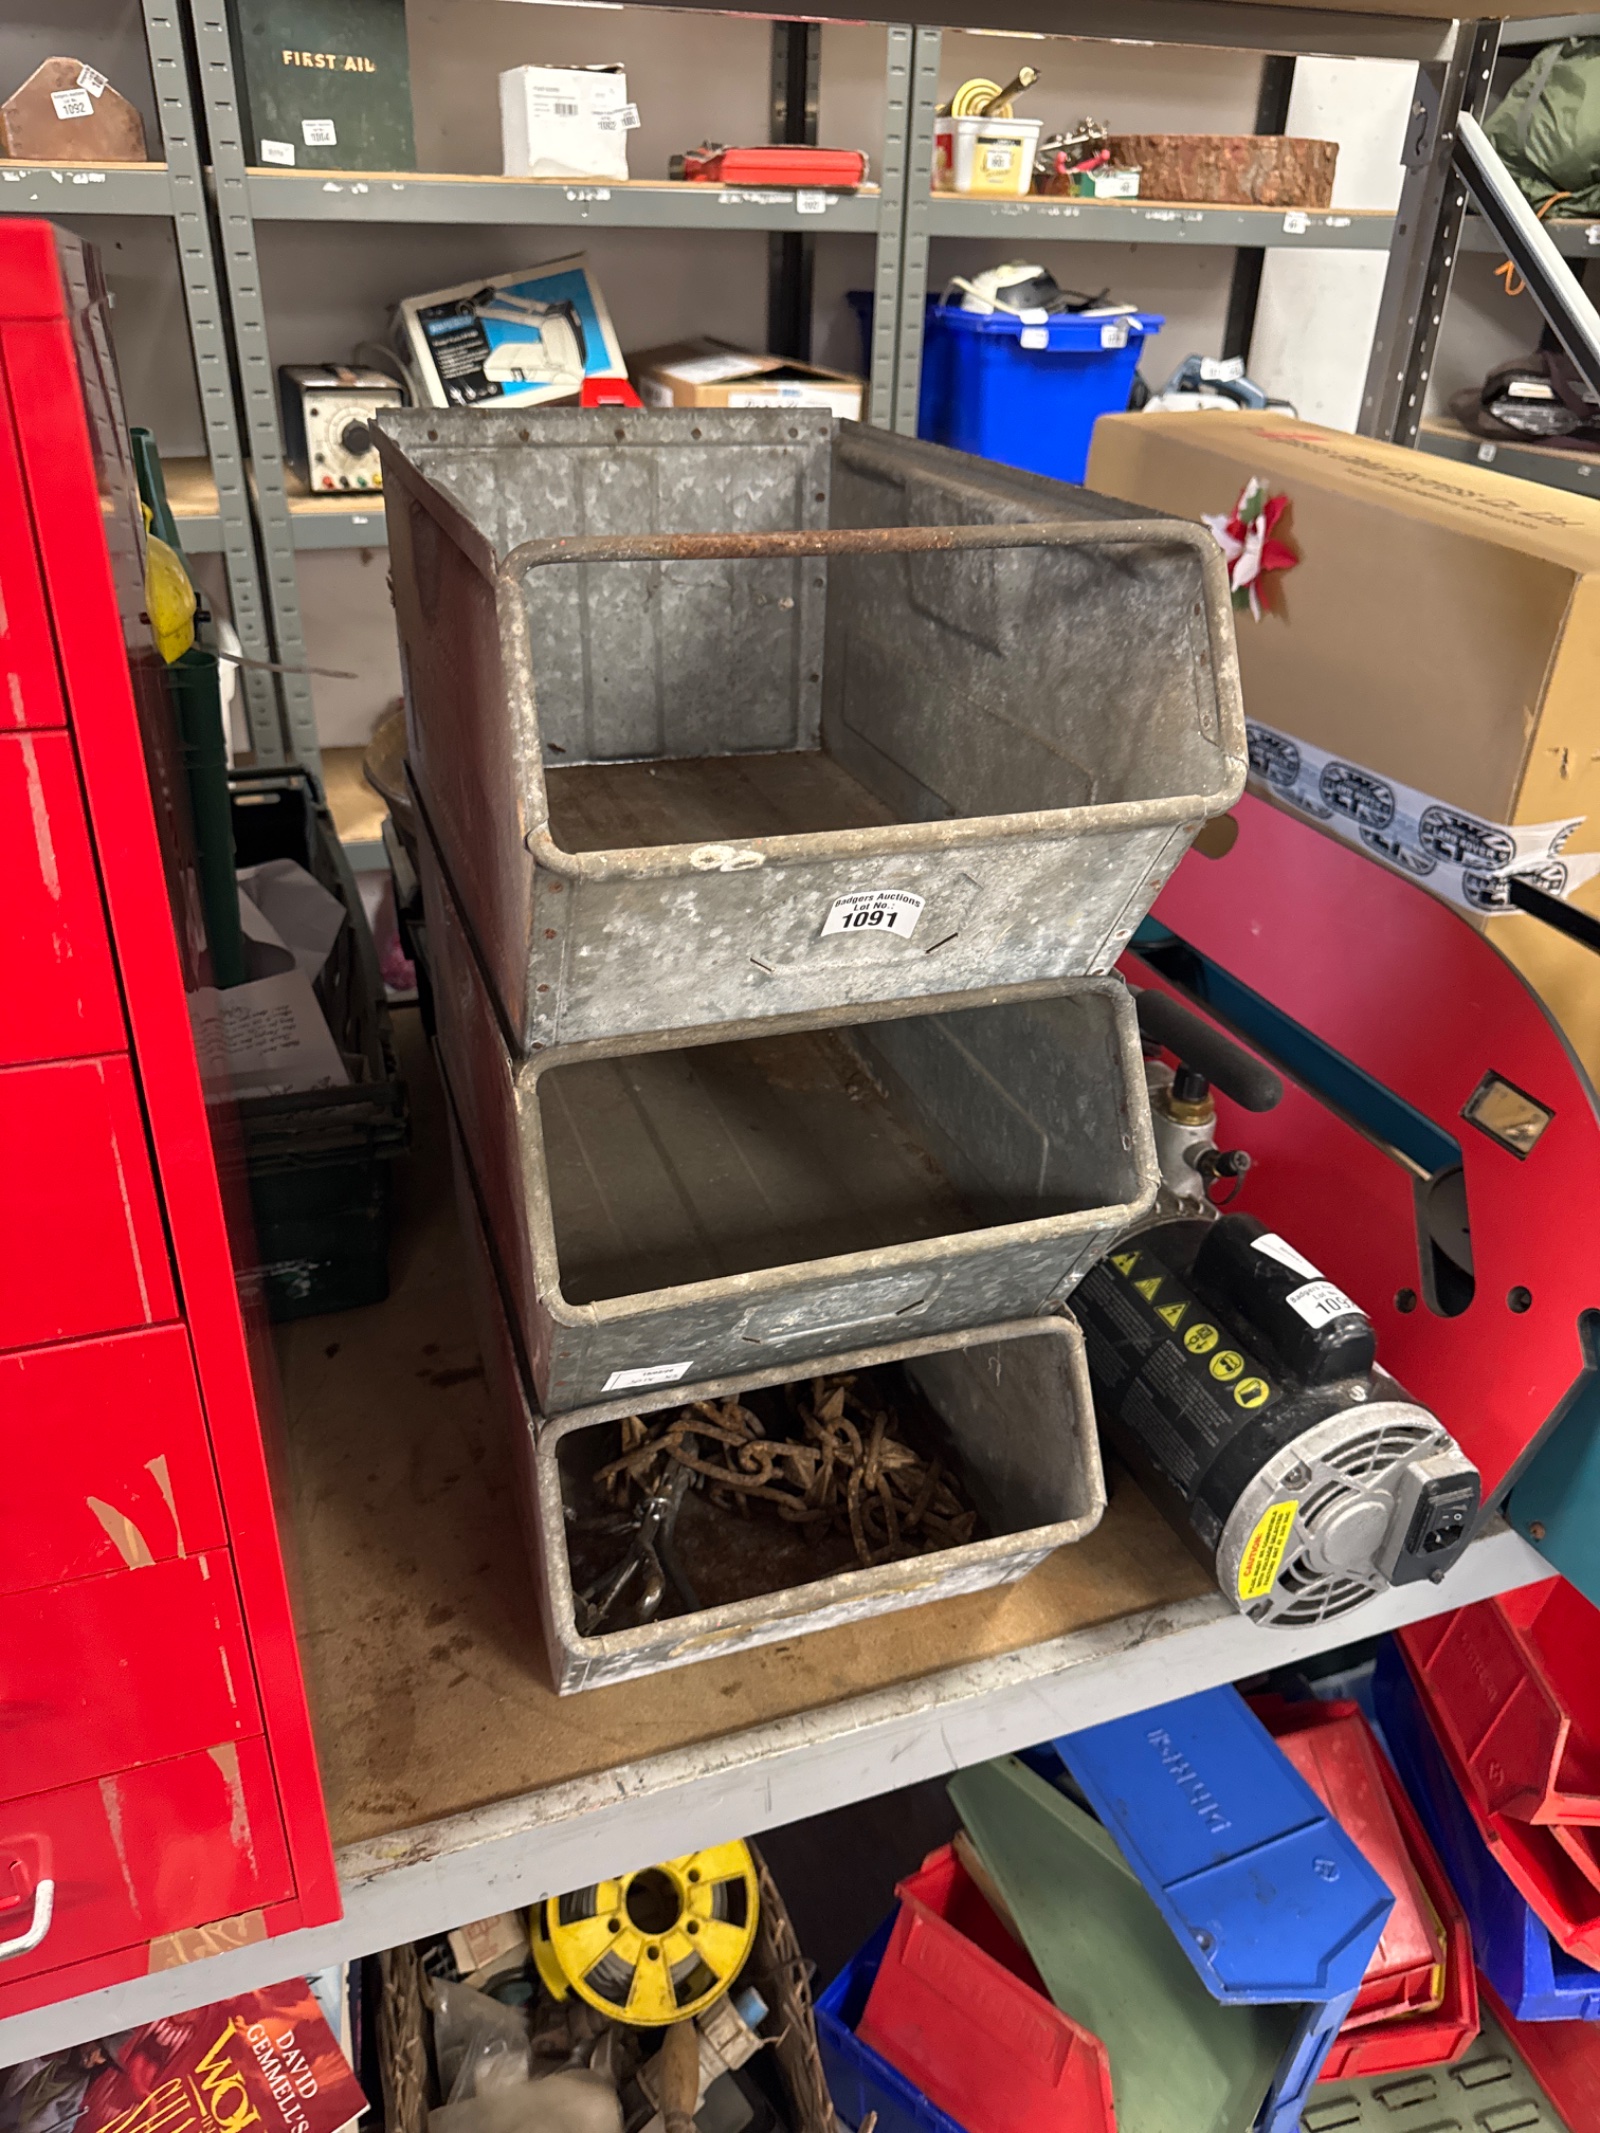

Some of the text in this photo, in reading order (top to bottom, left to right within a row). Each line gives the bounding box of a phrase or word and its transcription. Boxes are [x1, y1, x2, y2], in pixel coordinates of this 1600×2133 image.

[282, 50, 336, 70] FIRST
[1433, 827, 1458, 845] LAND
[1459, 837, 1496, 859] ROVER
[834, 892, 921, 908] Badgers Auctions
[853, 903, 870, 912] Lot
[842, 910, 898, 929] 1091
[1289, 1285, 1321, 1304] Badgers
[1315, 1296, 1356, 1315] 109
[1243, 1532, 1262, 1577] CAUTION:
[276, 2029, 319, 2100] DAVID
[246, 2023, 310, 2133] GEMMELL'S
